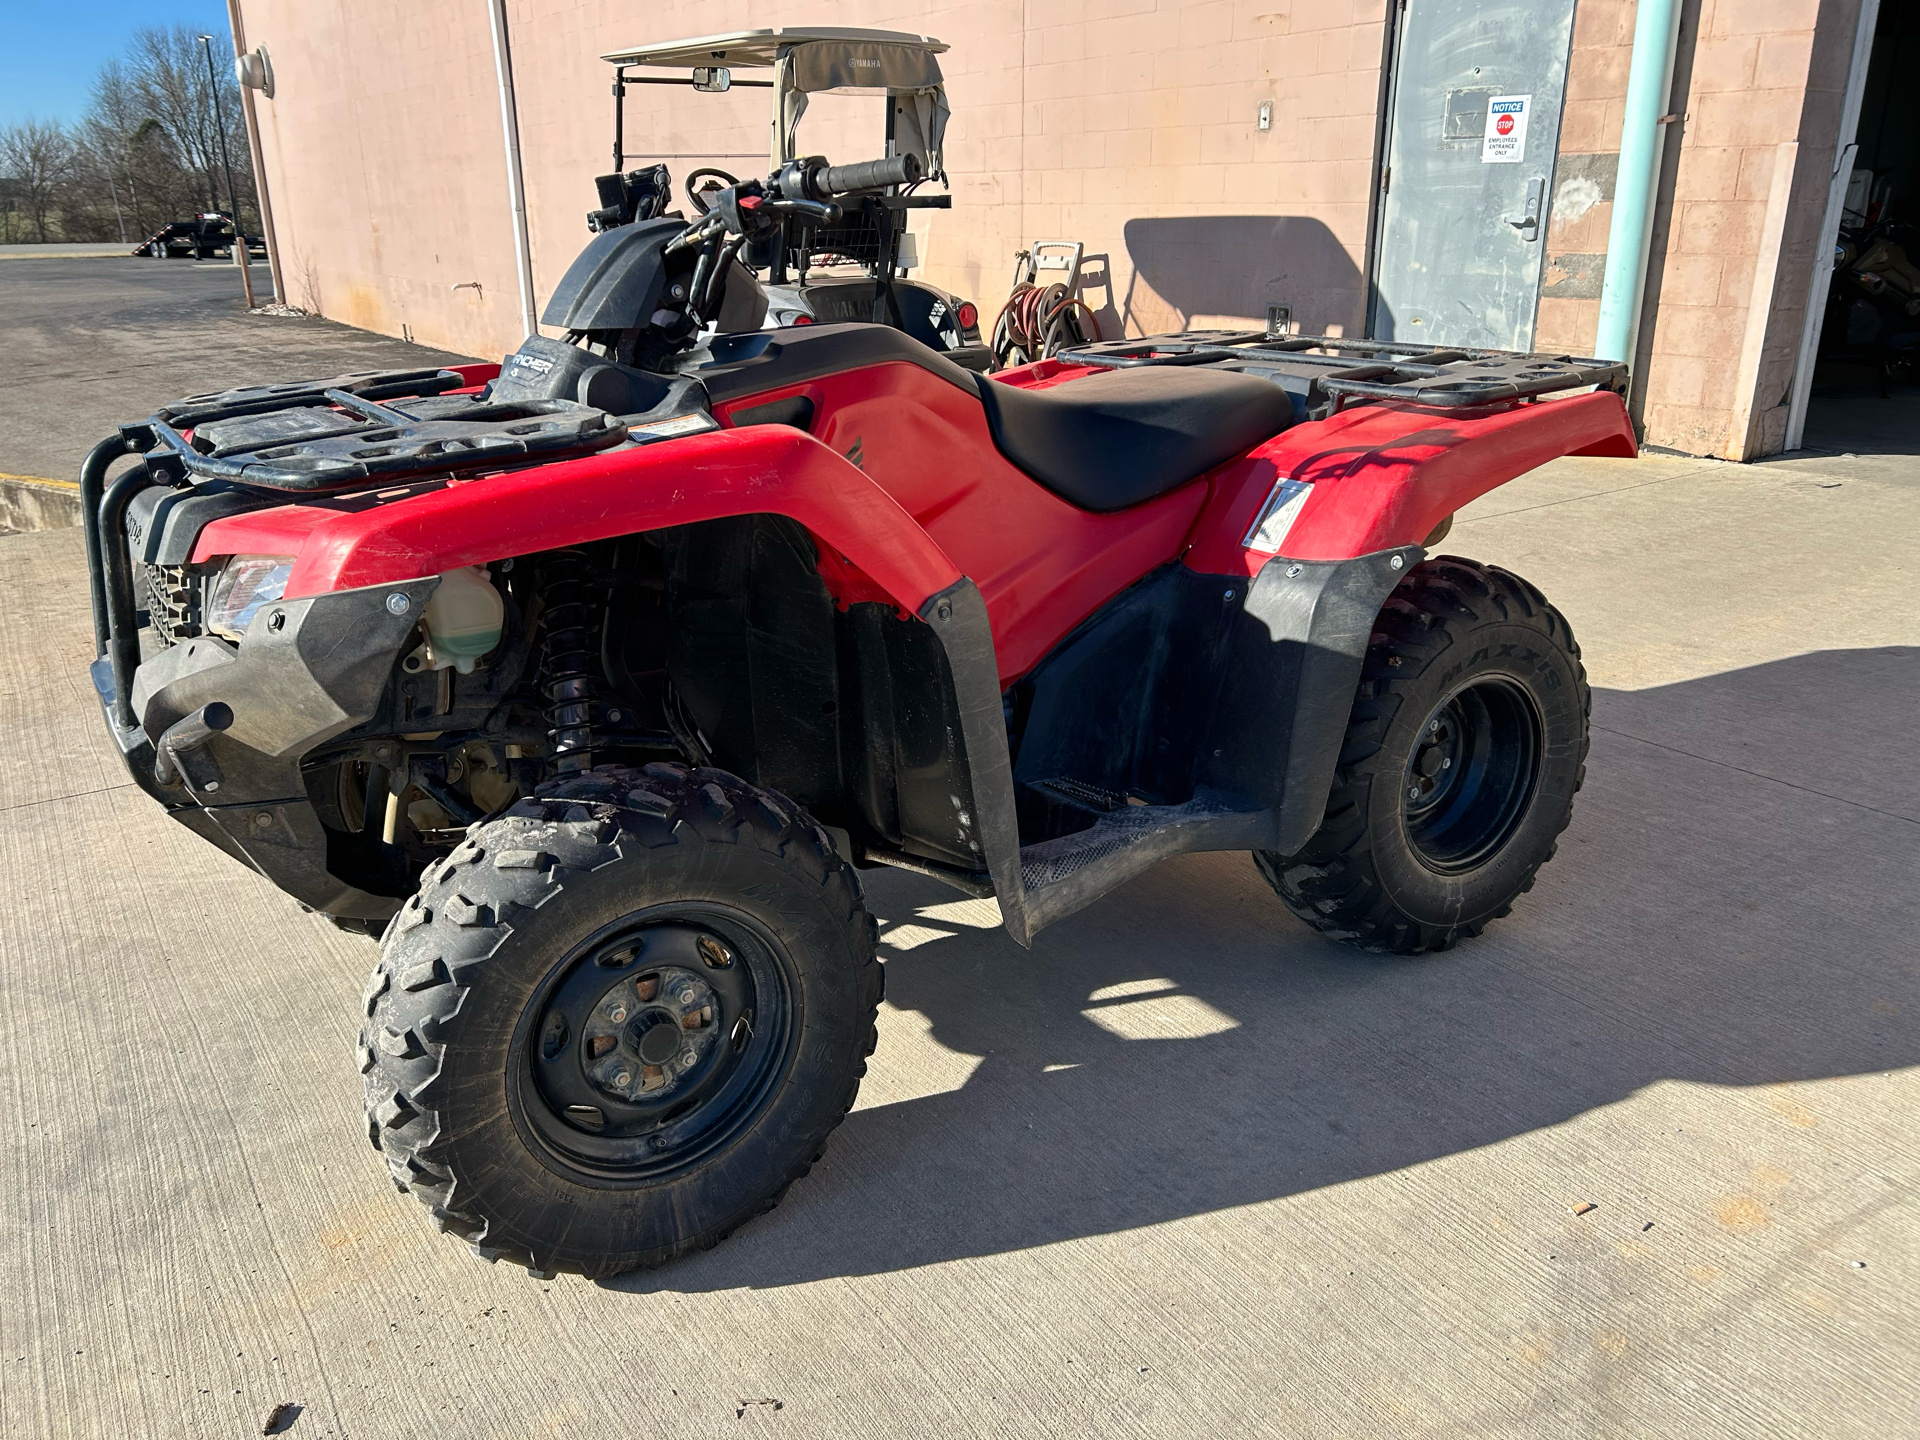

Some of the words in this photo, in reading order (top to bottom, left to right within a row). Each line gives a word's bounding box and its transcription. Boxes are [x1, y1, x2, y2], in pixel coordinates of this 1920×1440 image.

[856, 59, 881, 68] YAMAHA
[1494, 103, 1522, 112] NOTICE
[1498, 120, 1513, 129] STOP
[832, 299, 875, 318] YAMAH
[1437, 643, 1563, 695] MAXXIS
[737, 882, 840, 1077] MAXXIS
[554, 1189, 575, 1204] 2321
